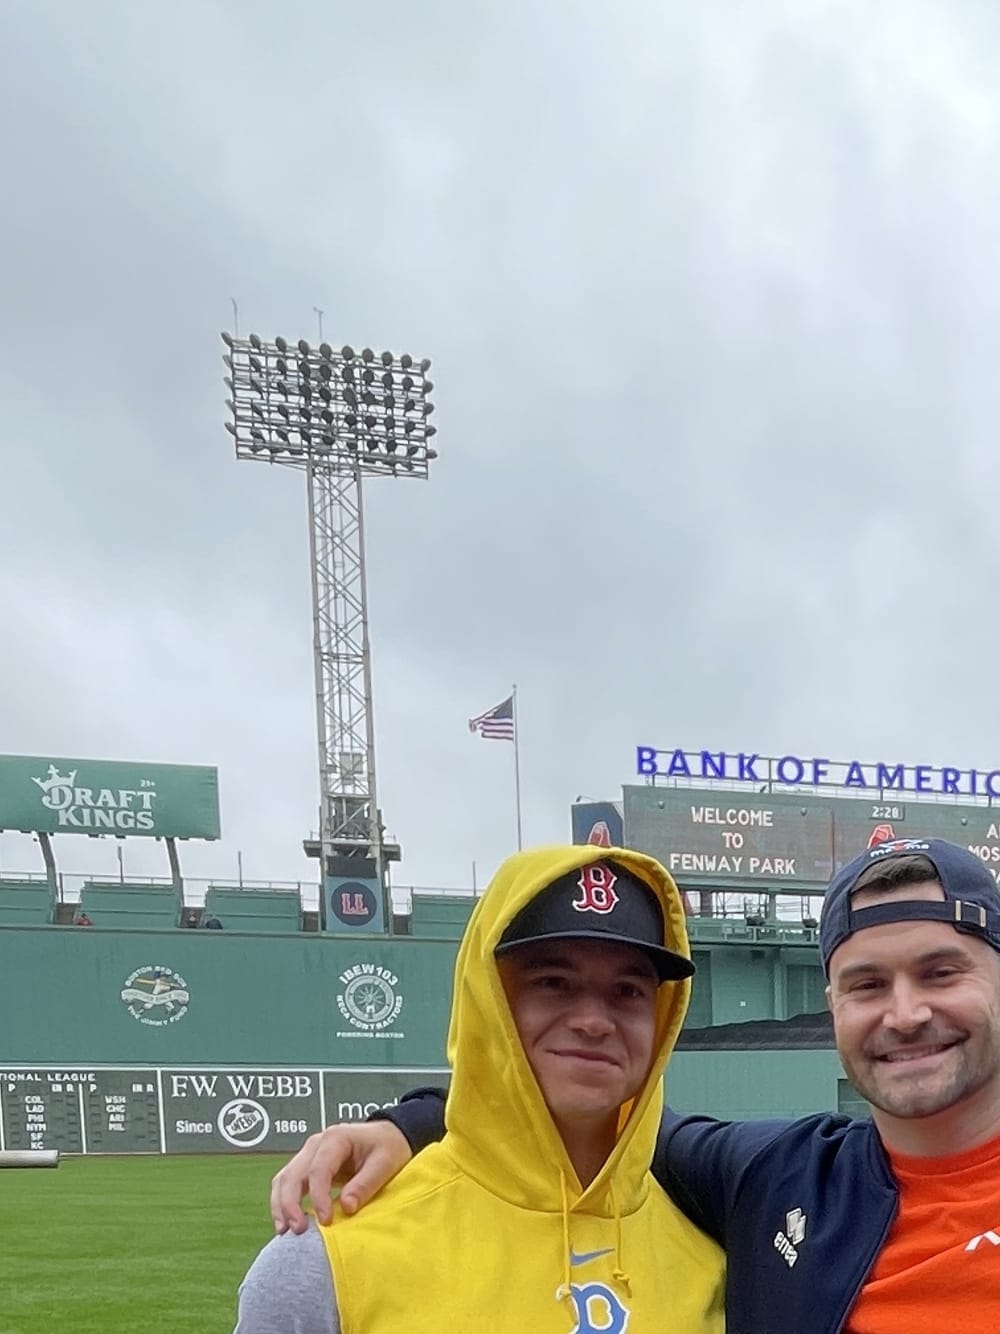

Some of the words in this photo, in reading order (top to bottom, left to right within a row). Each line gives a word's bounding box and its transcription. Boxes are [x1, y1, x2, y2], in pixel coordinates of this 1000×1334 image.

[636, 746, 760, 782] BANK
[777, 756, 829, 785] OF
[42, 785, 157, 810] DRAFT
[57, 805, 155, 830] KINGS
[691, 806, 773, 827] WELCOME
[722, 832, 744, 849] TO
[669, 853, 743, 874] FENWAY
[749, 856, 796, 875] PARK
[572, 861, 620, 914] B
[339, 964, 374, 984] IBEW
[376, 966, 398, 986] 103
[8, 1084, 16, 1092] P
[66, 1084, 75, 1092] R
[89, 1084, 97, 1092] P
[225, 1075, 312, 1098] WEBB
[24, 1096, 44, 1104] COL
[104, 1096, 126, 1104] WSH
[25, 1105, 44, 1113] LAD
[106, 1105, 126, 1113] CHC
[27, 1114, 44, 1122] PHI
[109, 1114, 125, 1122] ARI
[26, 1123, 46, 1132] NYM
[108, 1123, 125, 1132] MIL
[176, 1120, 213, 1134] Since
[274, 1120, 308, 1133] 1866
